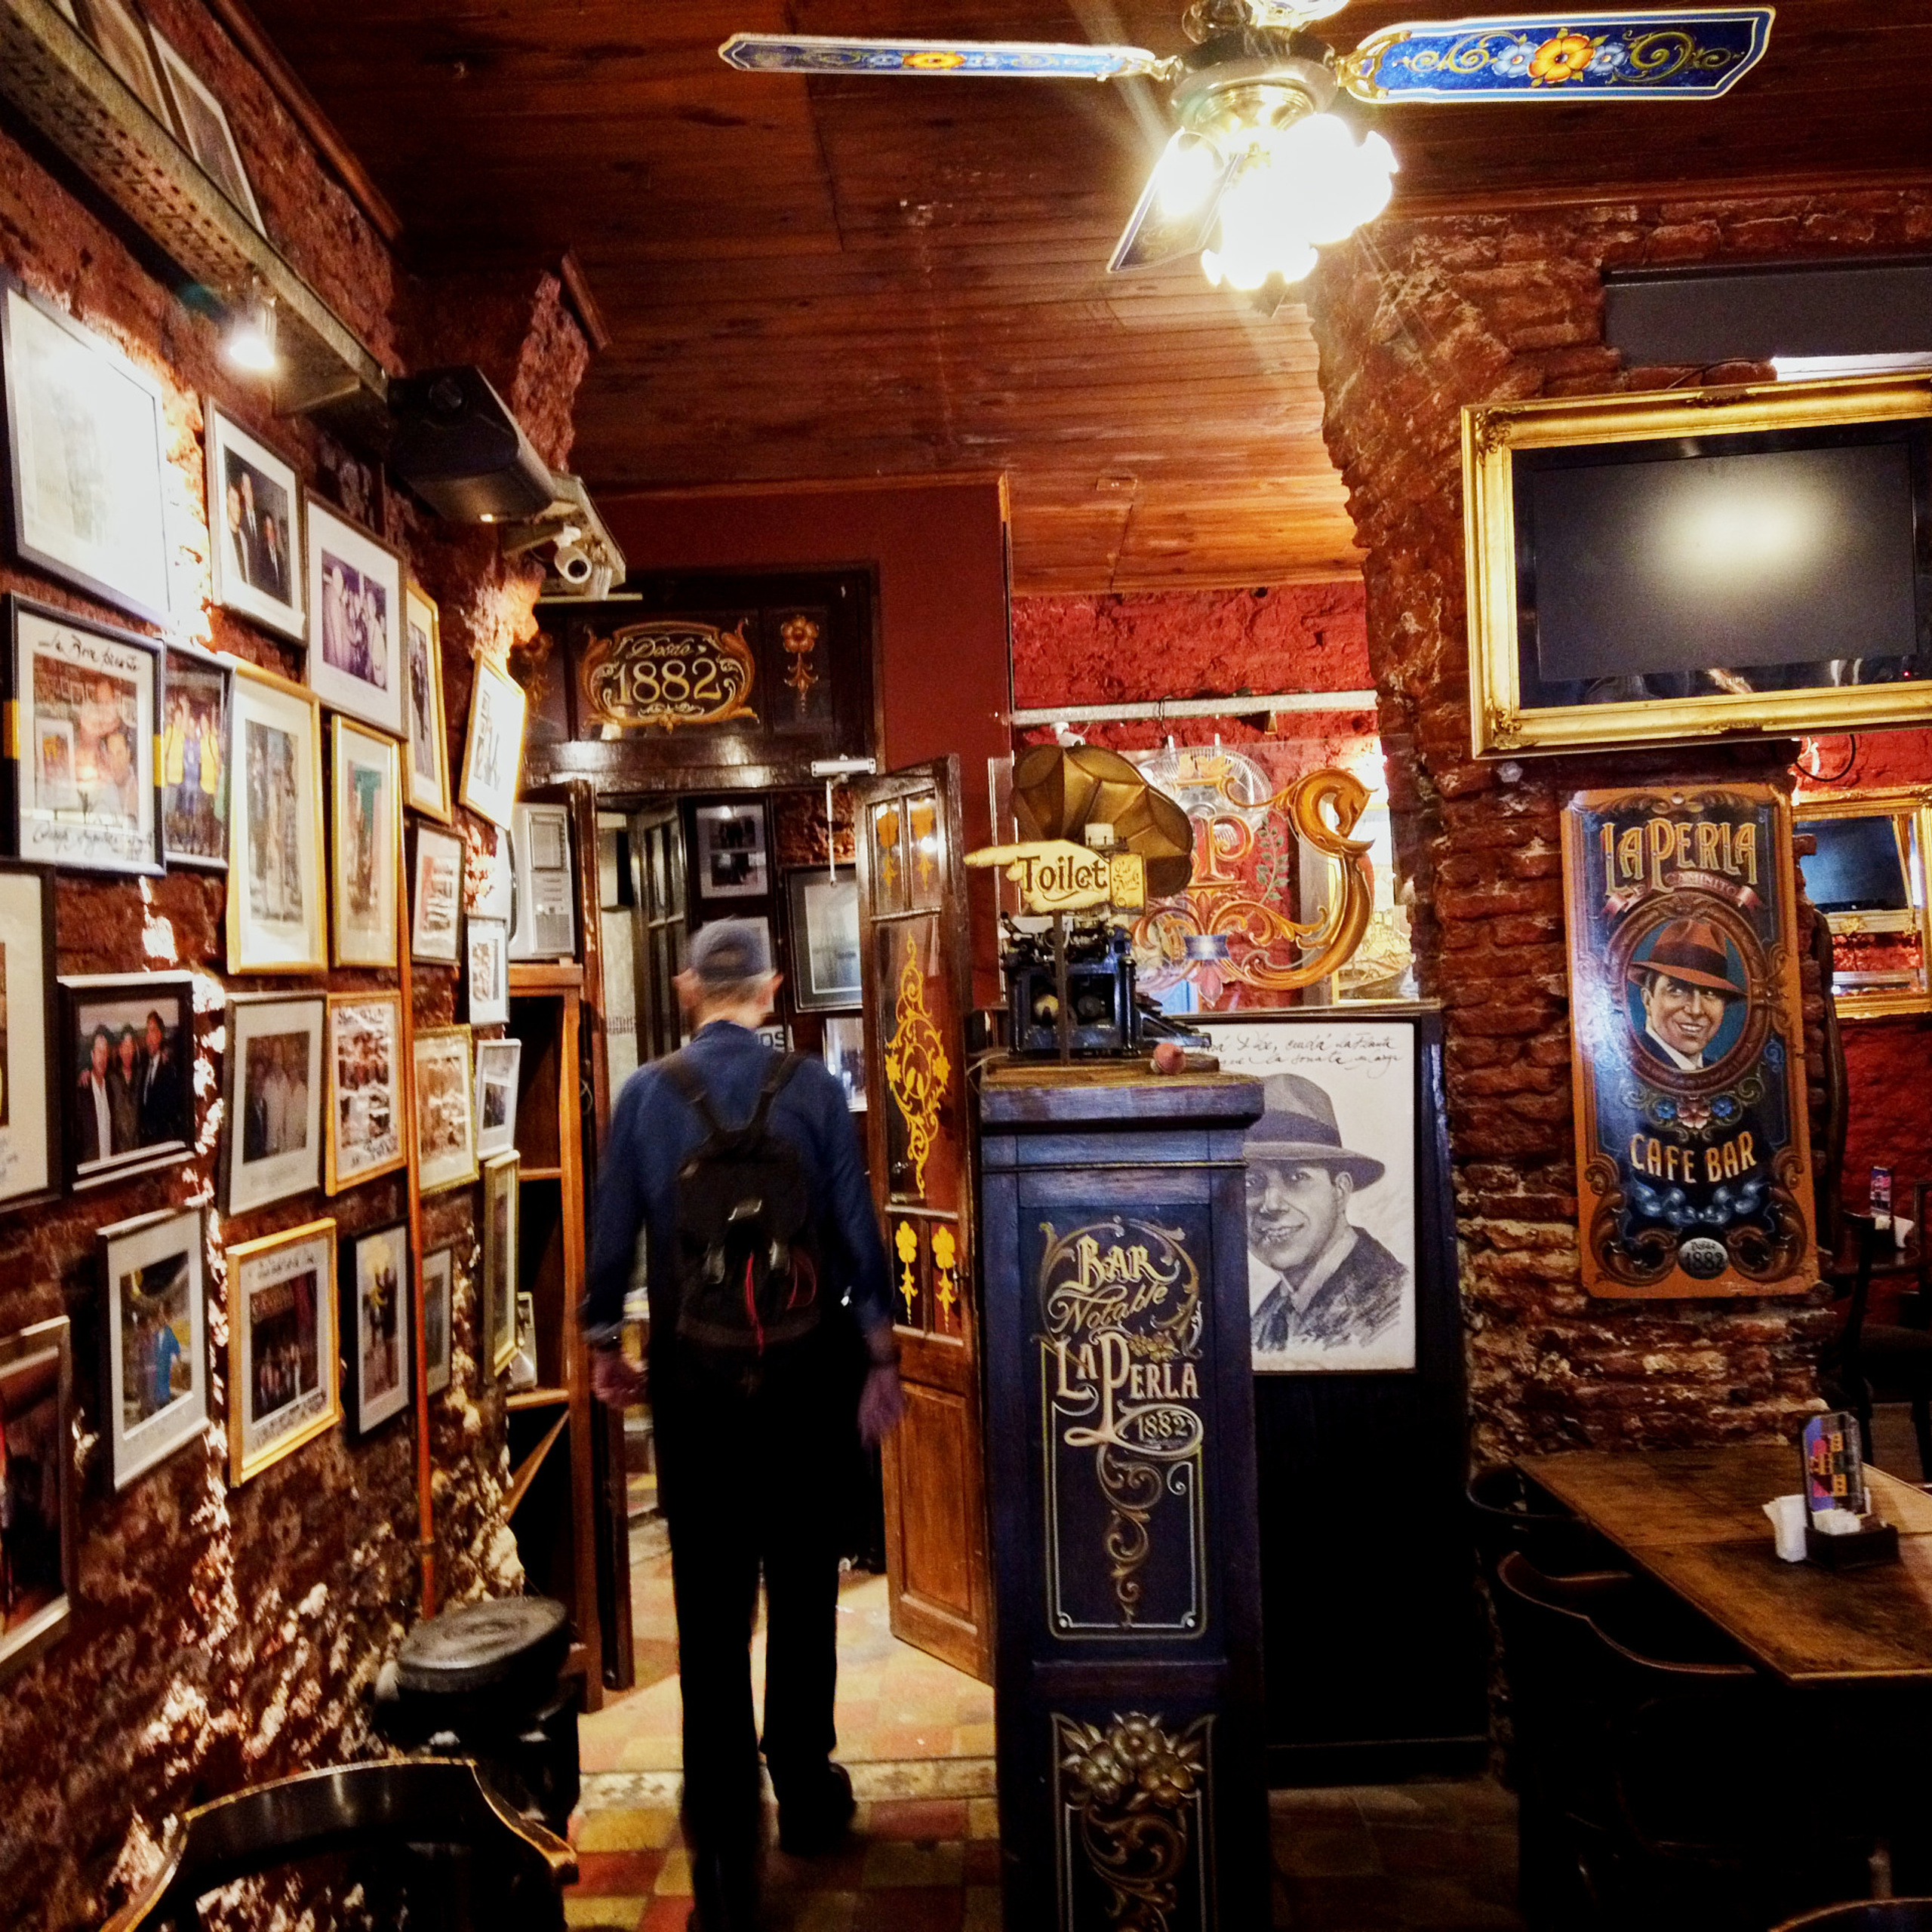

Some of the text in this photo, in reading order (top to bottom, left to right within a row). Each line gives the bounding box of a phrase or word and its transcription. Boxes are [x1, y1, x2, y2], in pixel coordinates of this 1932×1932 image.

[626, 635, 694, 660] Desde
[613, 657, 721, 705] 1882
[1017, 854, 1108, 893] Toilet
[1600, 817, 1758, 896] LA PERLA
[1664, 871, 1738, 896] CAMINITO
[1629, 1131, 1757, 1183] CAFE BAR
[1066, 1234, 1168, 1293] BAR
[1684, 1251, 1724, 1271] 1882
[1048, 1283, 1169, 1334] Notable
[1056, 1331, 1201, 1438] LA PERLA
[1137, 1411, 1188, 1438] 1882
